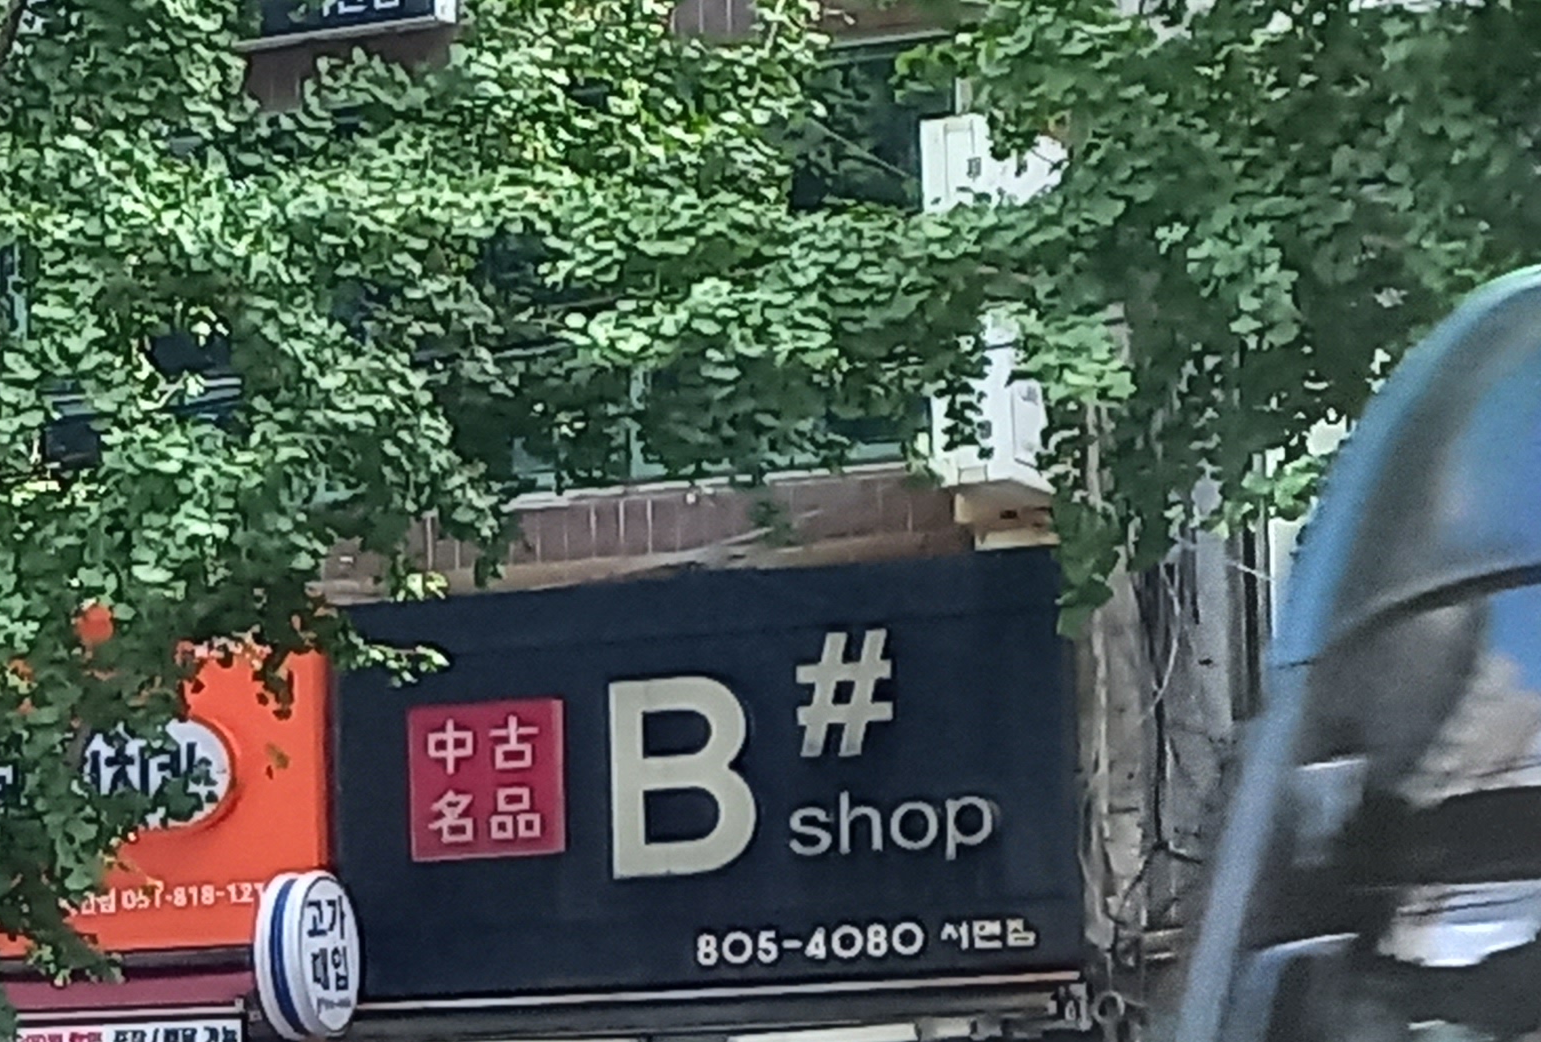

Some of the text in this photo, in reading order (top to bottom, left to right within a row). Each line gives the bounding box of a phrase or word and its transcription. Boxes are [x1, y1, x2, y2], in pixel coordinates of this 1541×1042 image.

[426, 714, 540, 776] 中古
[428, 785, 543, 846] 名品
[788, 791, 996, 860] shop
[306, 895, 346, 940] 고가
[695, 921, 925, 967] 805-4080
